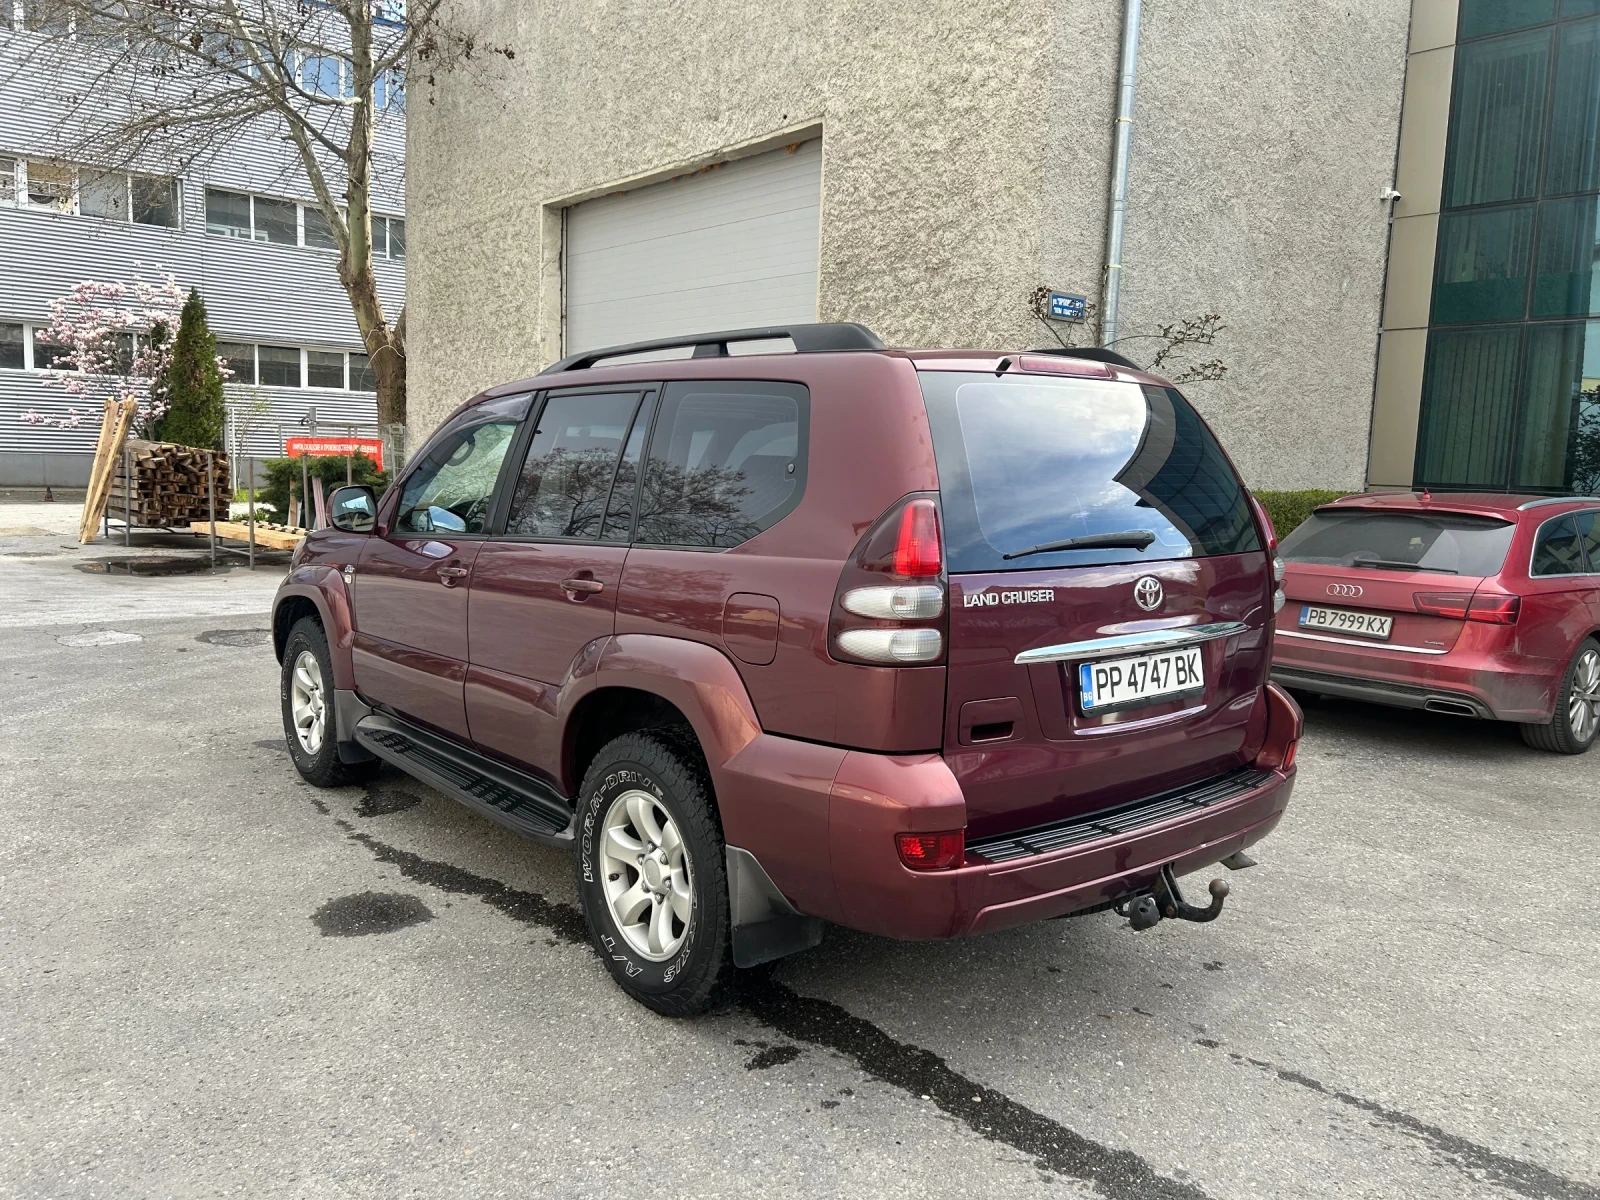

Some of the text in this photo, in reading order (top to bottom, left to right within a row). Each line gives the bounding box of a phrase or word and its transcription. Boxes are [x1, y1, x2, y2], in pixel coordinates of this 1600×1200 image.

[964, 589, 1055, 608] LAND CRUISER
[1308, 609, 1388, 634] PB 7999 KX
[1095, 652, 1200, 700] PP 4747 BK
[1083, 691, 1093, 702] BG
[582, 770, 664, 882] WORM-DRIVE
[600, 934, 643, 978] A/T
